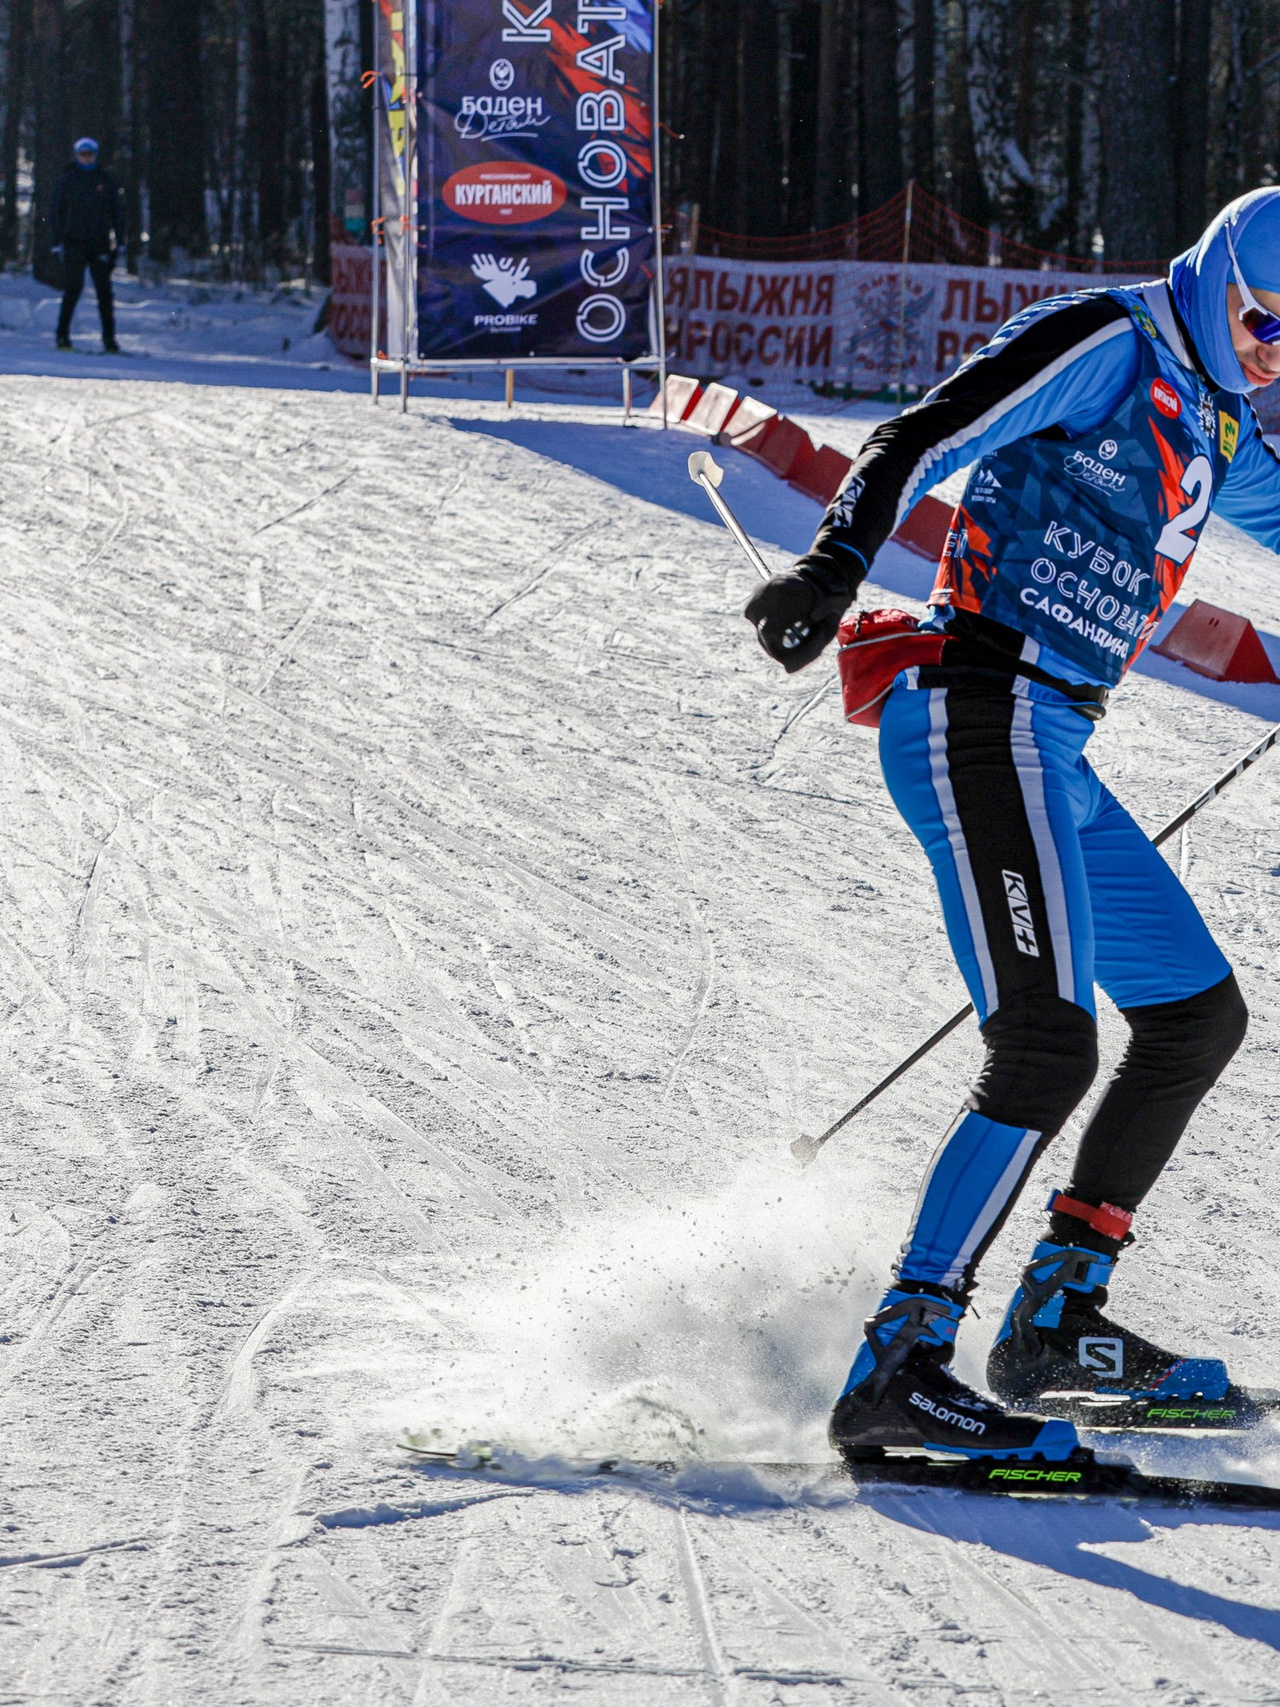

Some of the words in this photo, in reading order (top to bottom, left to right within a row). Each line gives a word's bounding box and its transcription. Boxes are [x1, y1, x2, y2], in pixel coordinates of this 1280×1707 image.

[455, 180, 553, 205] КУРГАНСКИЙ
[473, 314, 538, 326] PROBIKE
[1154, 455, 1213, 565] 2
[1043, 520, 1151, 596] КУБОК
[1147, 1408, 1237, 1419] FISCHER
[988, 1469, 1082, 1482] FISCHER
